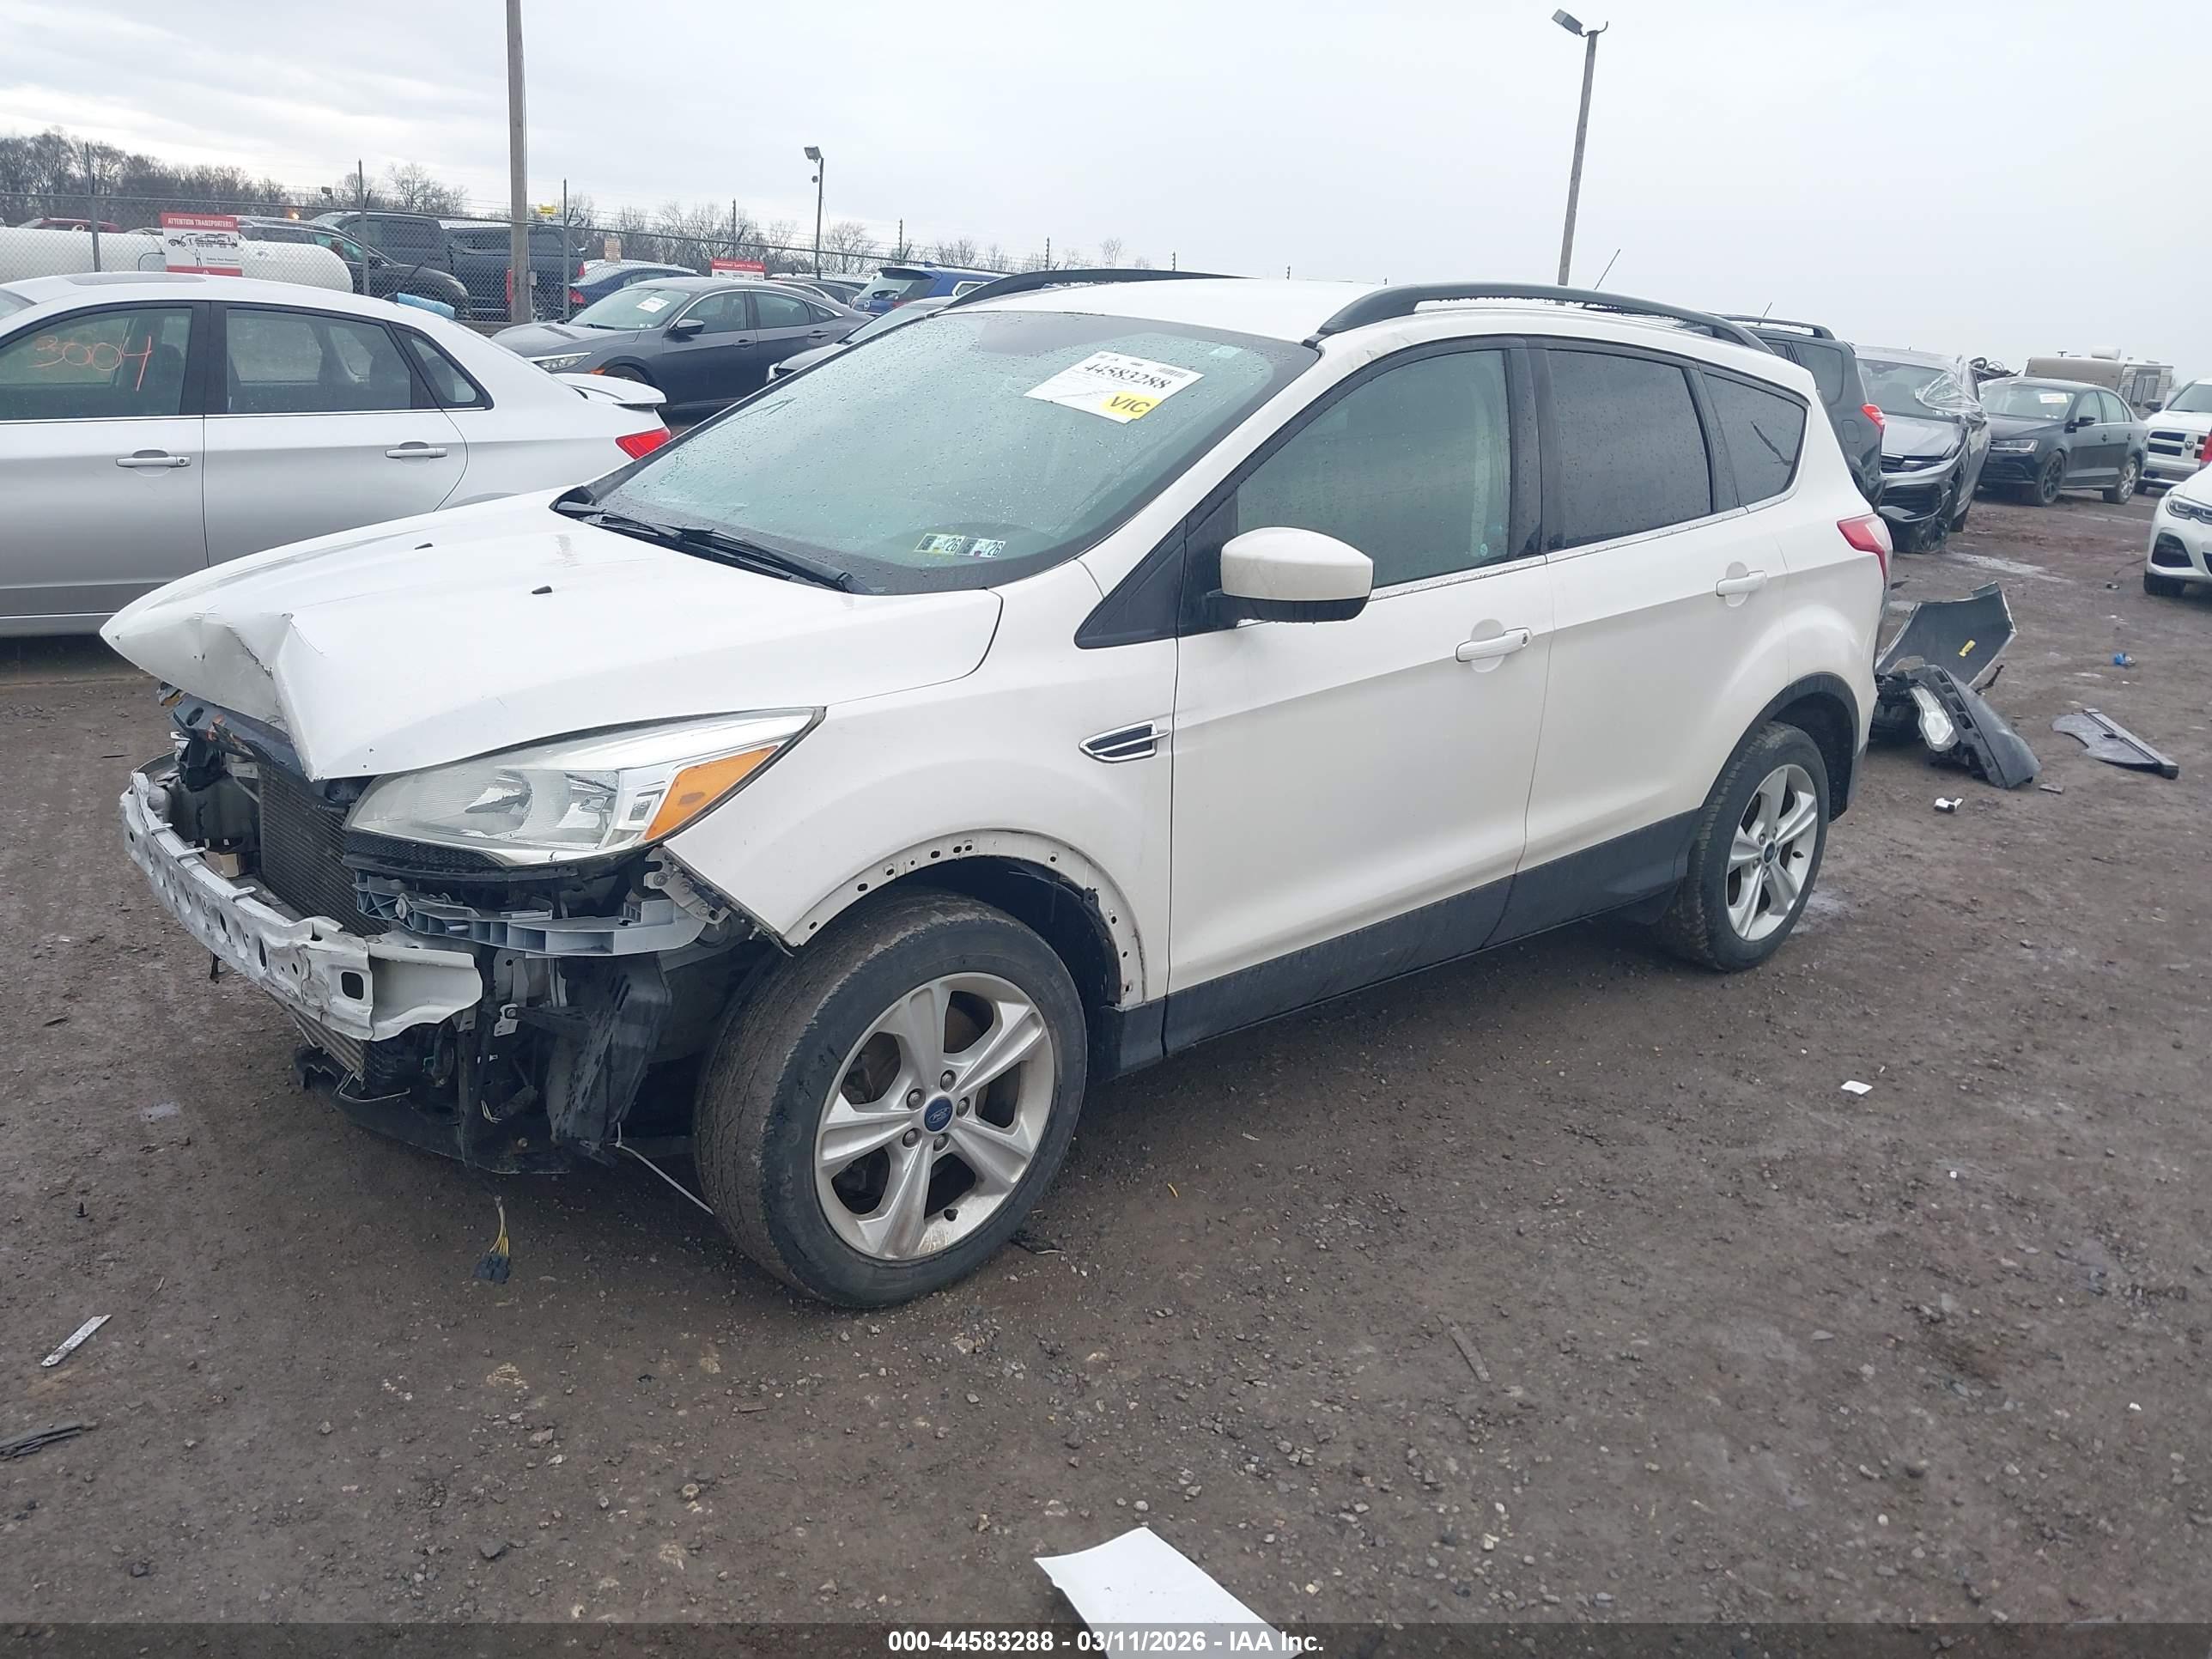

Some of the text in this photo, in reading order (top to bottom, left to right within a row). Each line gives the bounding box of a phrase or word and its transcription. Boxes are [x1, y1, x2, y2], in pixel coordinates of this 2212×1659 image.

[167, 217, 234, 228] ATTENTION TRANSPORTERS!
[27, 335, 153, 392] 3004
[1085, 363, 1171, 389] 44583288
[1109, 396, 1151, 413] VIC
[987, 541, 1004, 556] 26
